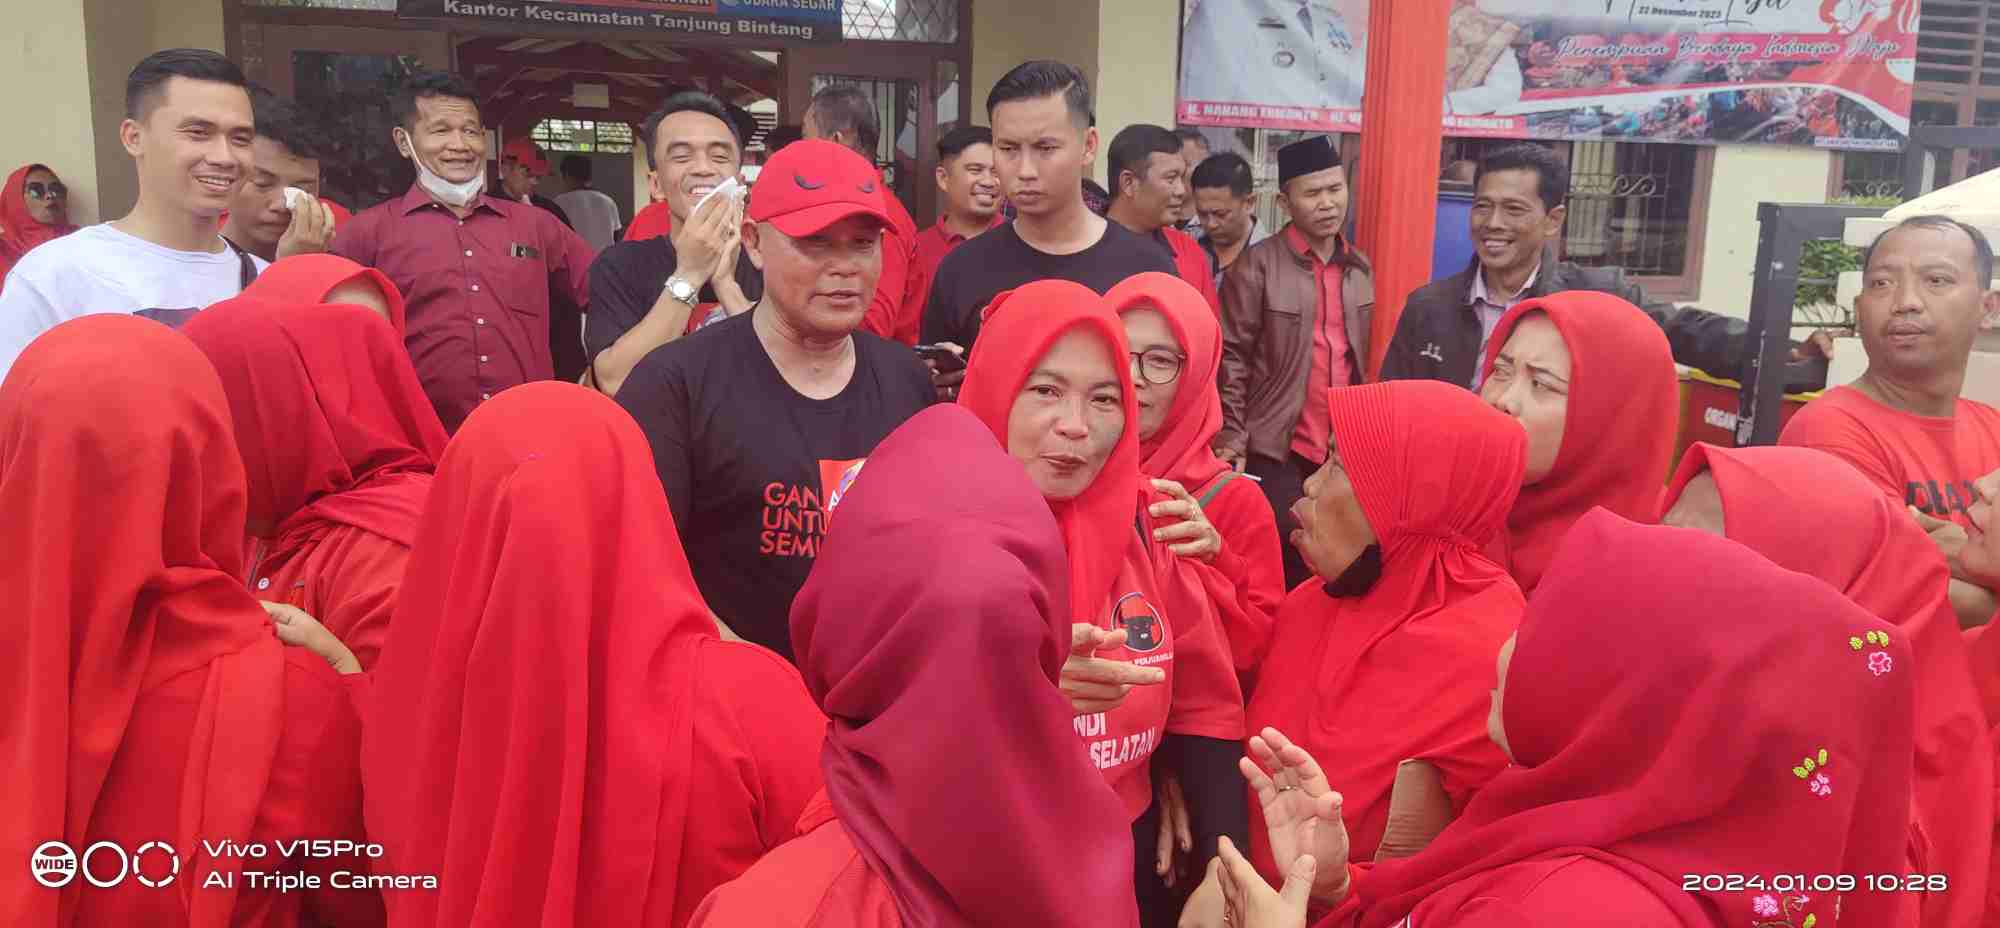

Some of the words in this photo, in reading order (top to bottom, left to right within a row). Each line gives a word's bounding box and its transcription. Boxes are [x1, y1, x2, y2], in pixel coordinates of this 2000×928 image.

[444, 0, 517, 18] Kantor
[525, 5, 645, 27] Kecamatan
[651, 14, 731, 34] Tanjung
[738, 20, 813, 39] Bintang
[1089, 727, 1156, 769] SELATAN
